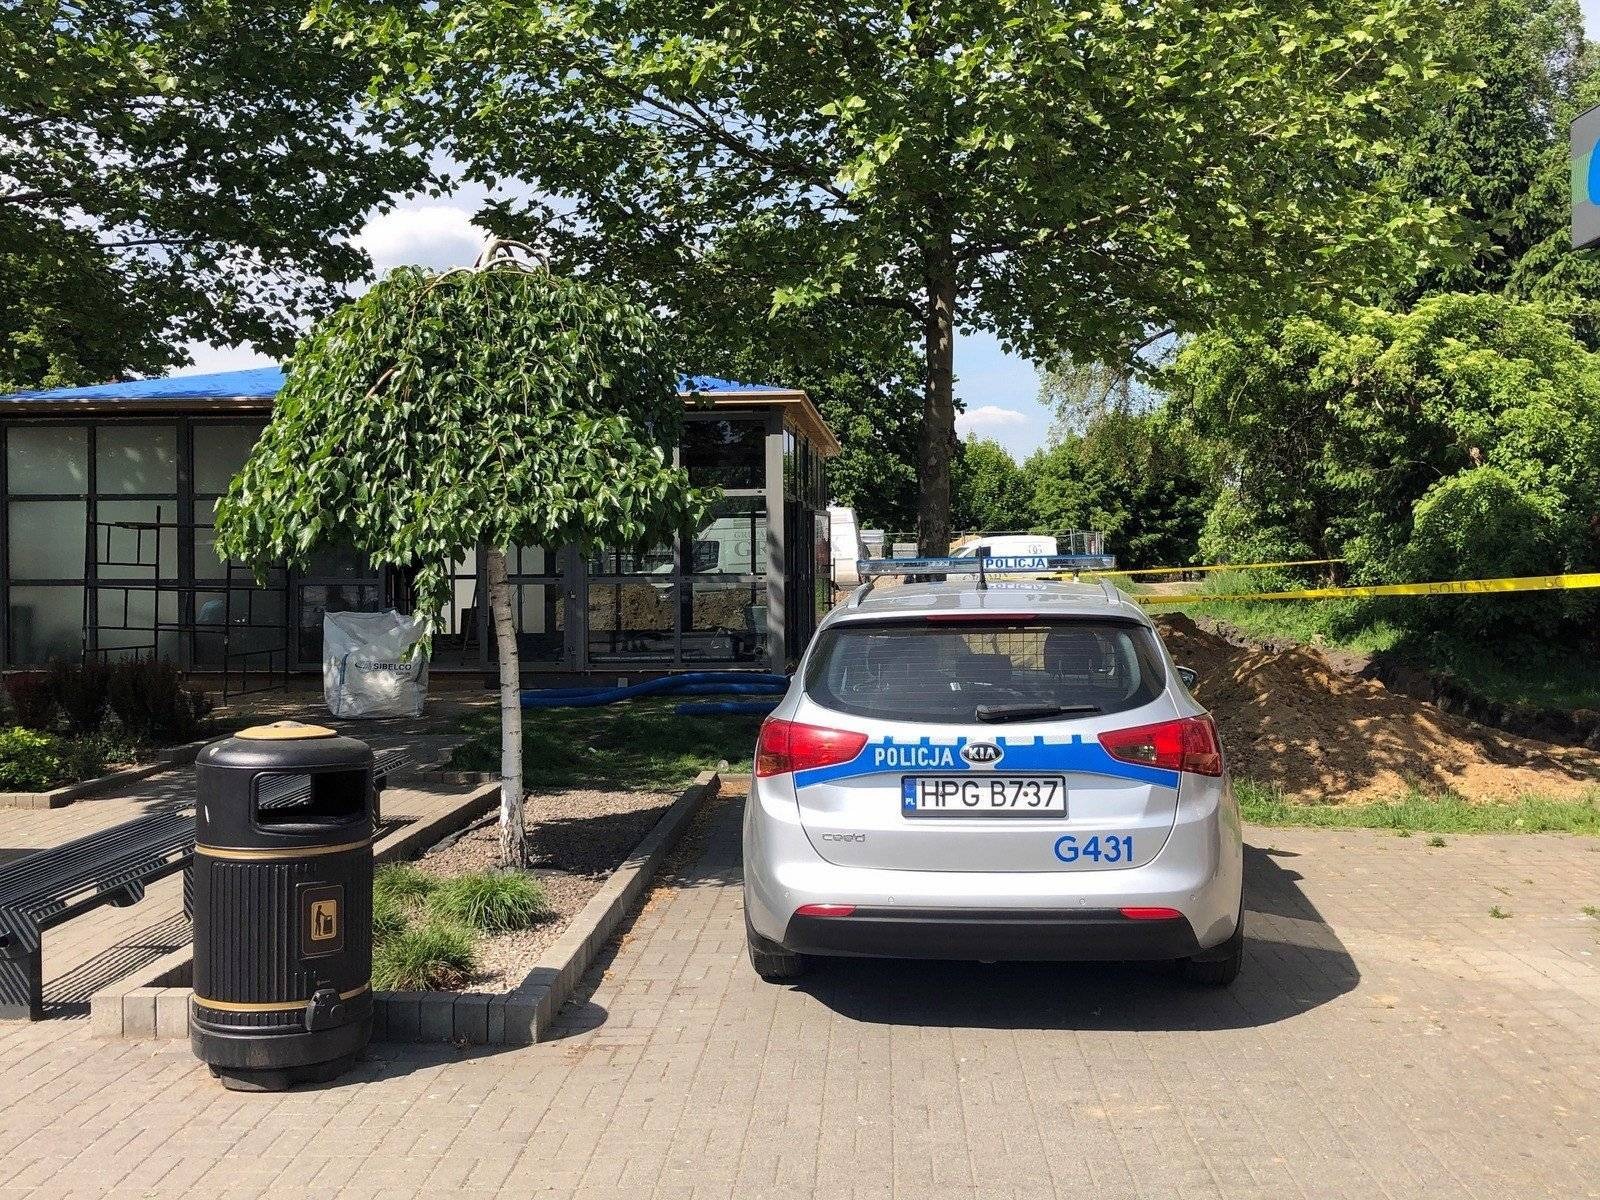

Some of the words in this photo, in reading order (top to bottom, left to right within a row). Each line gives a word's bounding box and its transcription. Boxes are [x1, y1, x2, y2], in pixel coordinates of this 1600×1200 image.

[986, 558, 1046, 568] POLICJA
[373, 662, 412, 671] SIBELCO
[874, 746, 954, 767] POLICJA
[967, 746, 997, 760] KIA
[921, 780, 981, 808] HPG
[990, 780, 1059, 808] B737
[905, 797, 916, 806] PL
[1054, 835, 1133, 863] G431
